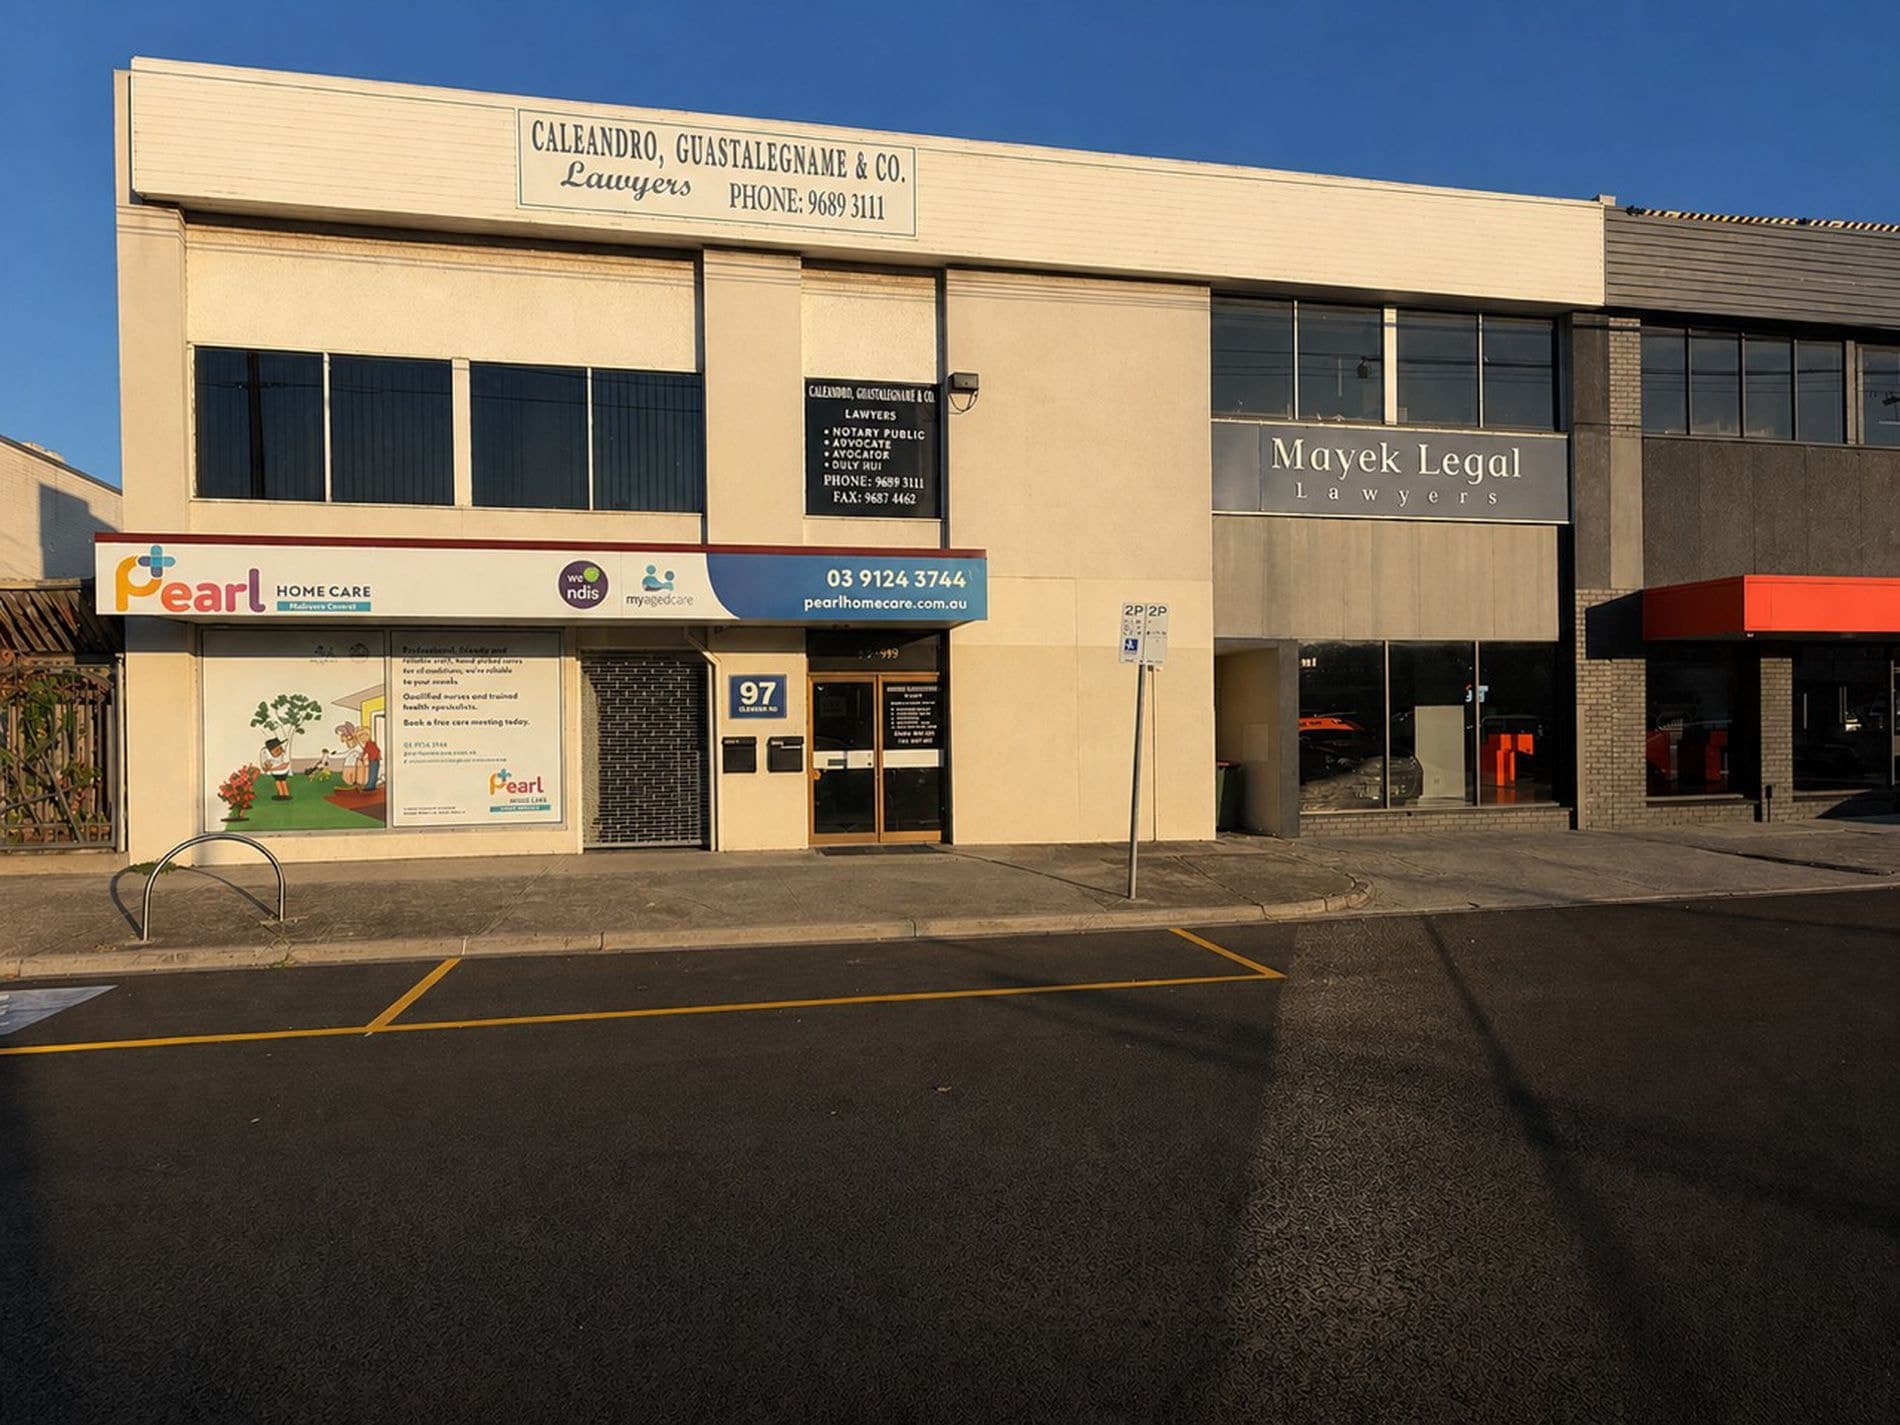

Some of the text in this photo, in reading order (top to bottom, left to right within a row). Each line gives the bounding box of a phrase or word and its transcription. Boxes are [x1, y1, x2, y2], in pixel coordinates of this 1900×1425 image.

[531, 119, 906, 183] CALEANDRO, GUASTALEGNAME & CO.
[560, 160, 691, 201] Lawyers
[729, 182, 884, 220] PHONE: 9689 3111
[845, 409, 897, 421] LAWYERS
[832, 427, 925, 440] NOTARY PUBLIC
[832, 438, 891, 449] ADVOCATE
[1272, 437, 1522, 485] Mayek Legal
[824, 475, 872, 487] PHONE:
[902, 477, 924, 489] 3111
[833, 491, 862, 503] FAX:
[115, 545, 266, 613] Pearl
[827, 569, 967, 588] 03 9124 3744
[276, 585, 371, 598] HOME CARE
[567, 585, 600, 600] ndis
[626, 594, 694, 608] myagedcare
[804, 595, 967, 612] pearlhomecare.com.au
[1125, 604, 1144, 616] 2P
[1149, 605, 1168, 617] 2P
[740, 681, 777, 705] 97
[489, 768, 545, 796] Pearl
